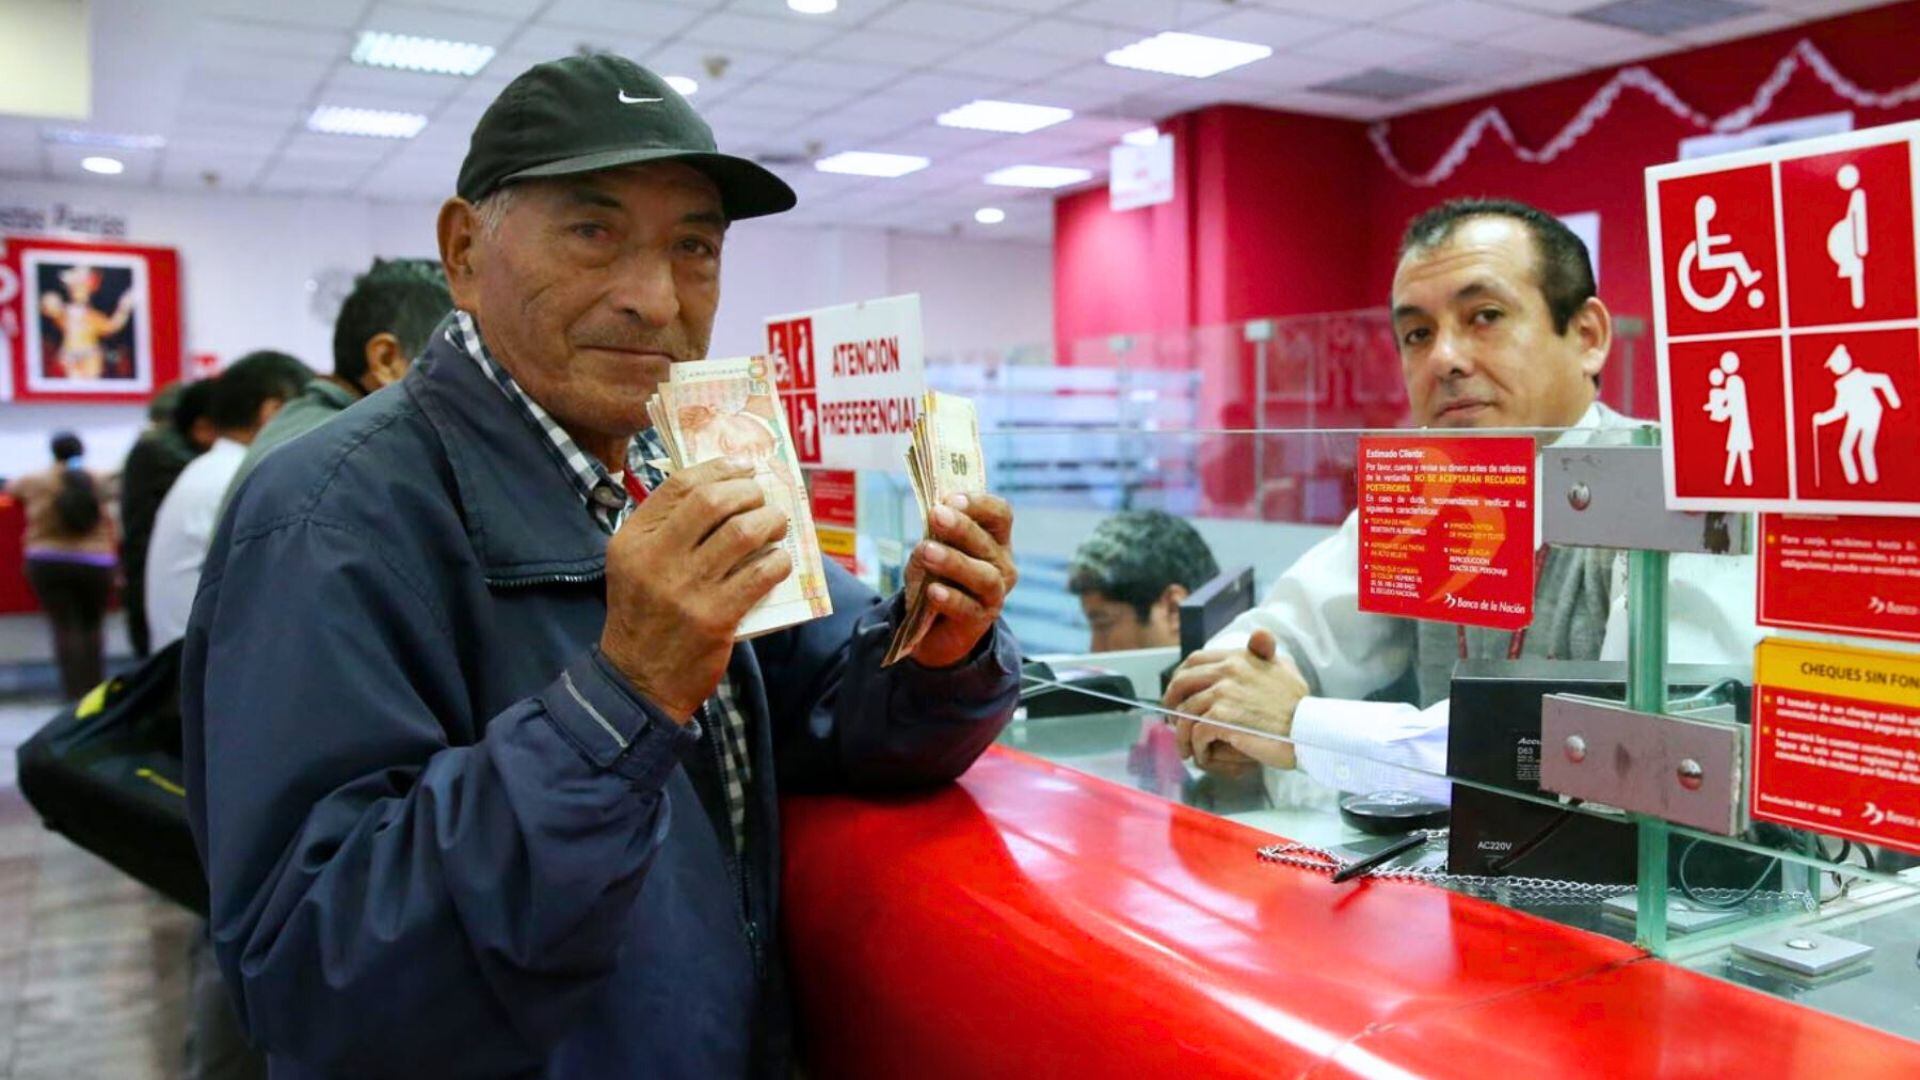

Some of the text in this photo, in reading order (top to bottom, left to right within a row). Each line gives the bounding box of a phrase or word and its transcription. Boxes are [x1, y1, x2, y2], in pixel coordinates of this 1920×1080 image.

[833, 337, 900, 377] ATENCION
[821, 397, 916, 436] PREFERENCIAL
[1366, 449, 1425, 458] Estimado Cliente:
[950, 452, 968, 476] 50
[1448, 464, 1468, 472] dinero
[1469, 465, 1487, 473] antes
[1414, 474, 1425, 482] NO
[1427, 474, 1437, 483] SE
[1484, 475, 1526, 484] RECLAMOS
[1366, 494, 1374, 502] En
[1457, 597, 1526, 614] Banco de la Nación
[1801, 662, 1862, 682] CHEQUES
[1864, 670, 1887, 685] SIN
[1516, 746, 1534, 755] D63
[1477, 841, 1512, 850] AC220V
